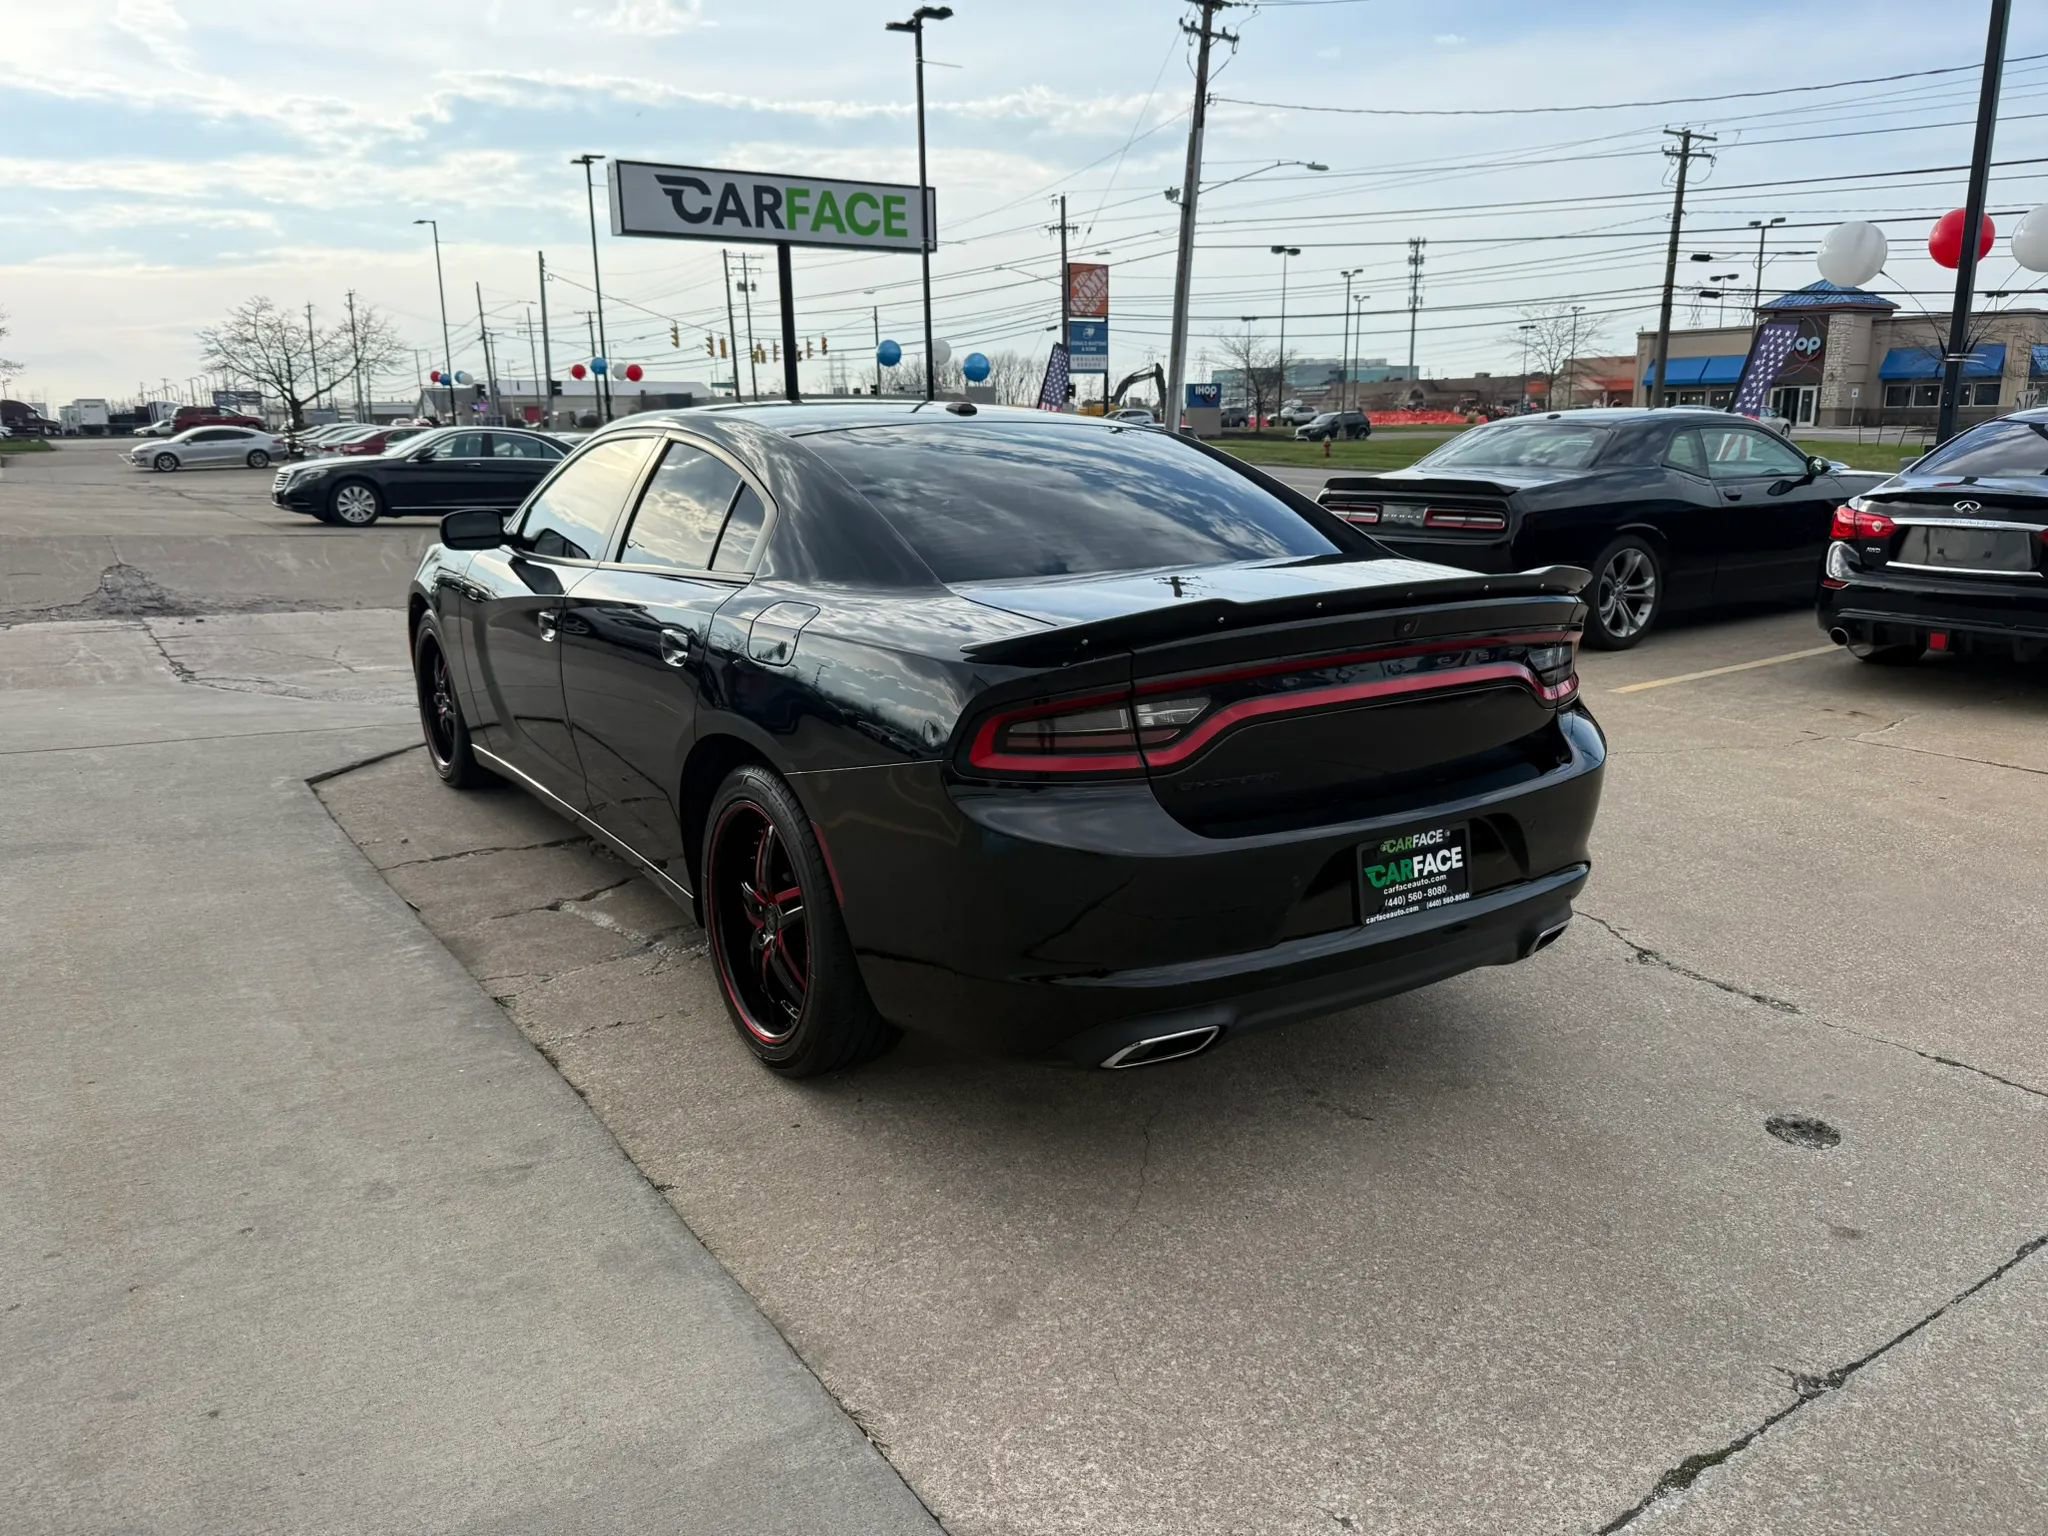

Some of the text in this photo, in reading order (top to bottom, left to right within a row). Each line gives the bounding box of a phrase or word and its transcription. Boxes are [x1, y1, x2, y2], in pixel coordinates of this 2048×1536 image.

[654, 174, 908, 238] CARFACE
[1383, 829, 1443, 853] CARFACE
[1364, 846, 1463, 889] CARFACE
[1383, 874, 1447, 895] carfaceauto.com
[1365, 905, 1419, 924] carfaceauto.com
[1426, 899, 1442, 909] (440)
[1384, 895, 1406, 907] (440)
